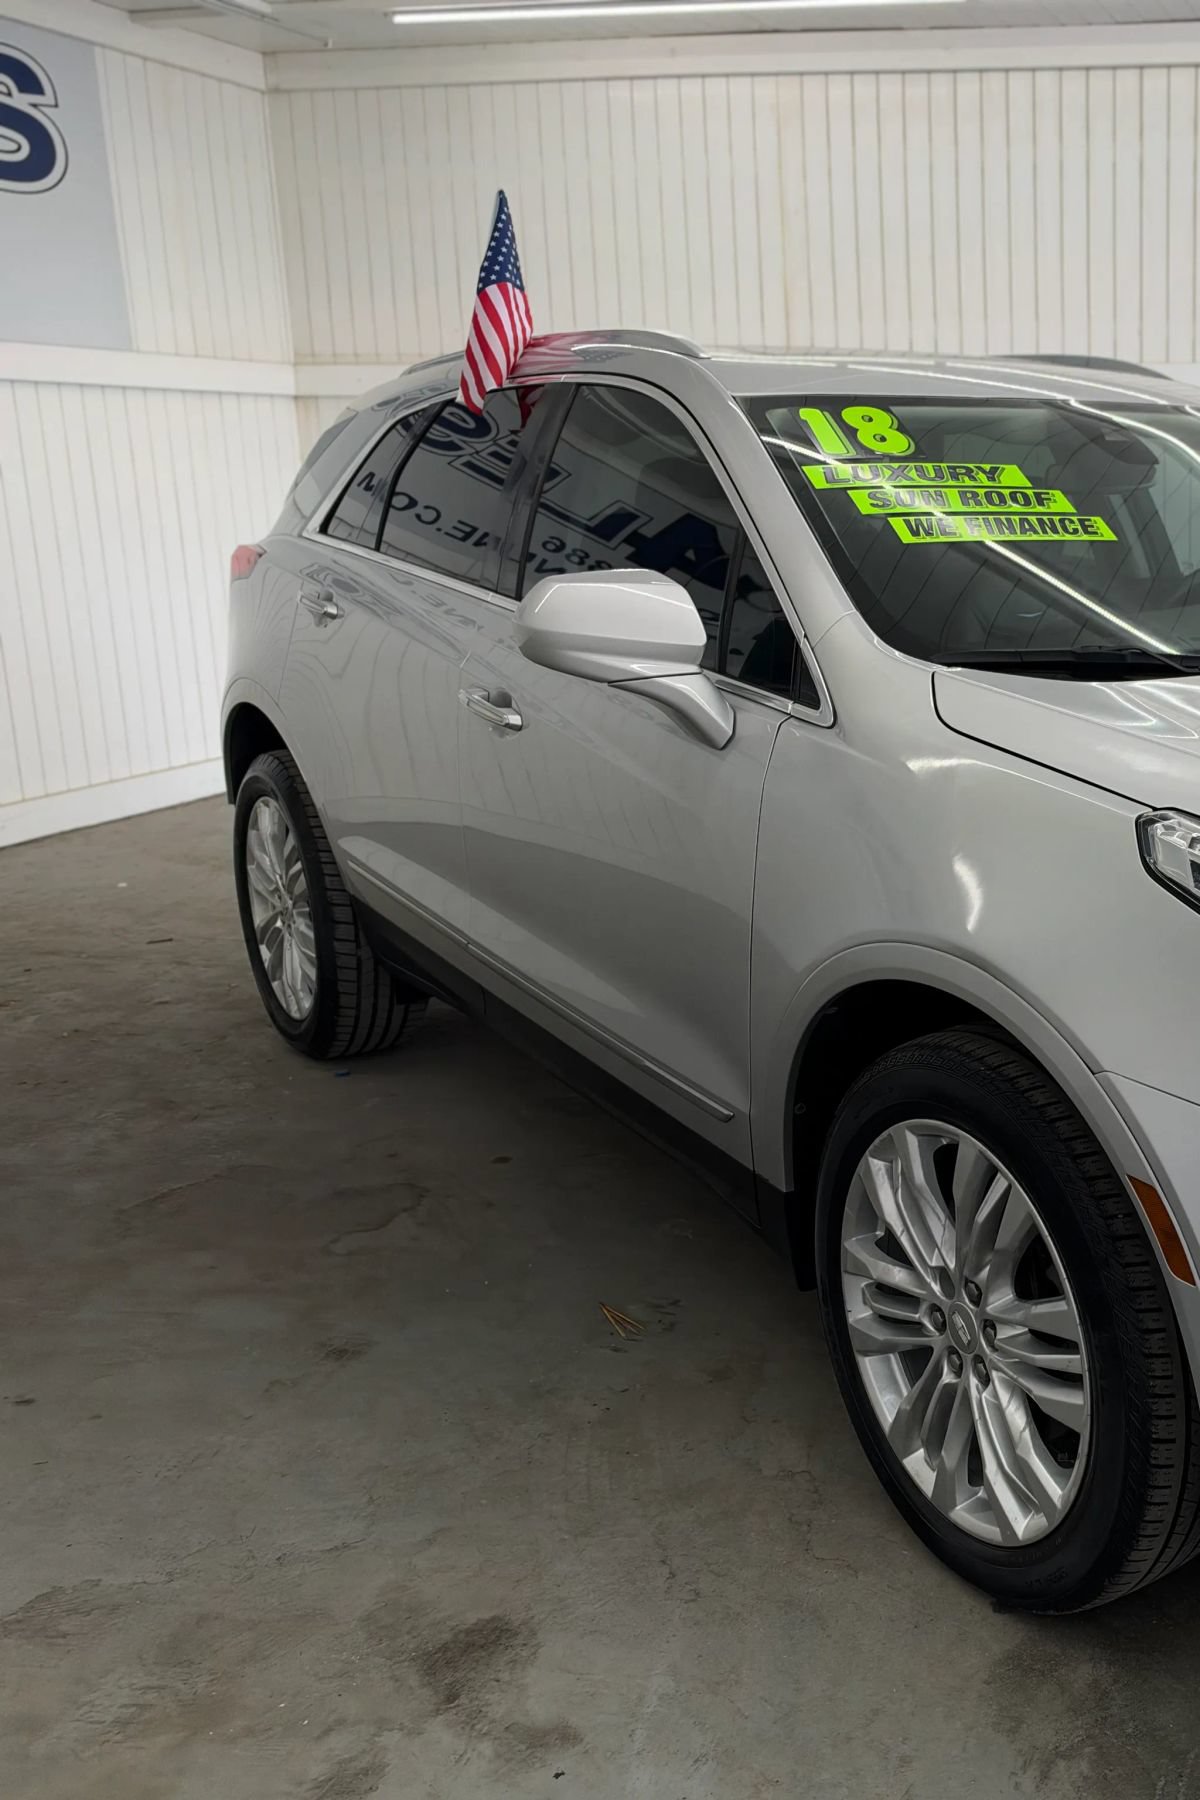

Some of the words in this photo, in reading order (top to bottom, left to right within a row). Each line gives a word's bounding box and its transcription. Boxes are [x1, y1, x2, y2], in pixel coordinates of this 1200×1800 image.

[799, 405, 915, 457] 18
[822, 464, 1005, 485] LUXURY
[867, 489, 952, 509] SUN
[959, 489, 1057, 509] ROOF
[902, 517, 958, 539] WE
[966, 516, 1105, 538] FINANCE
